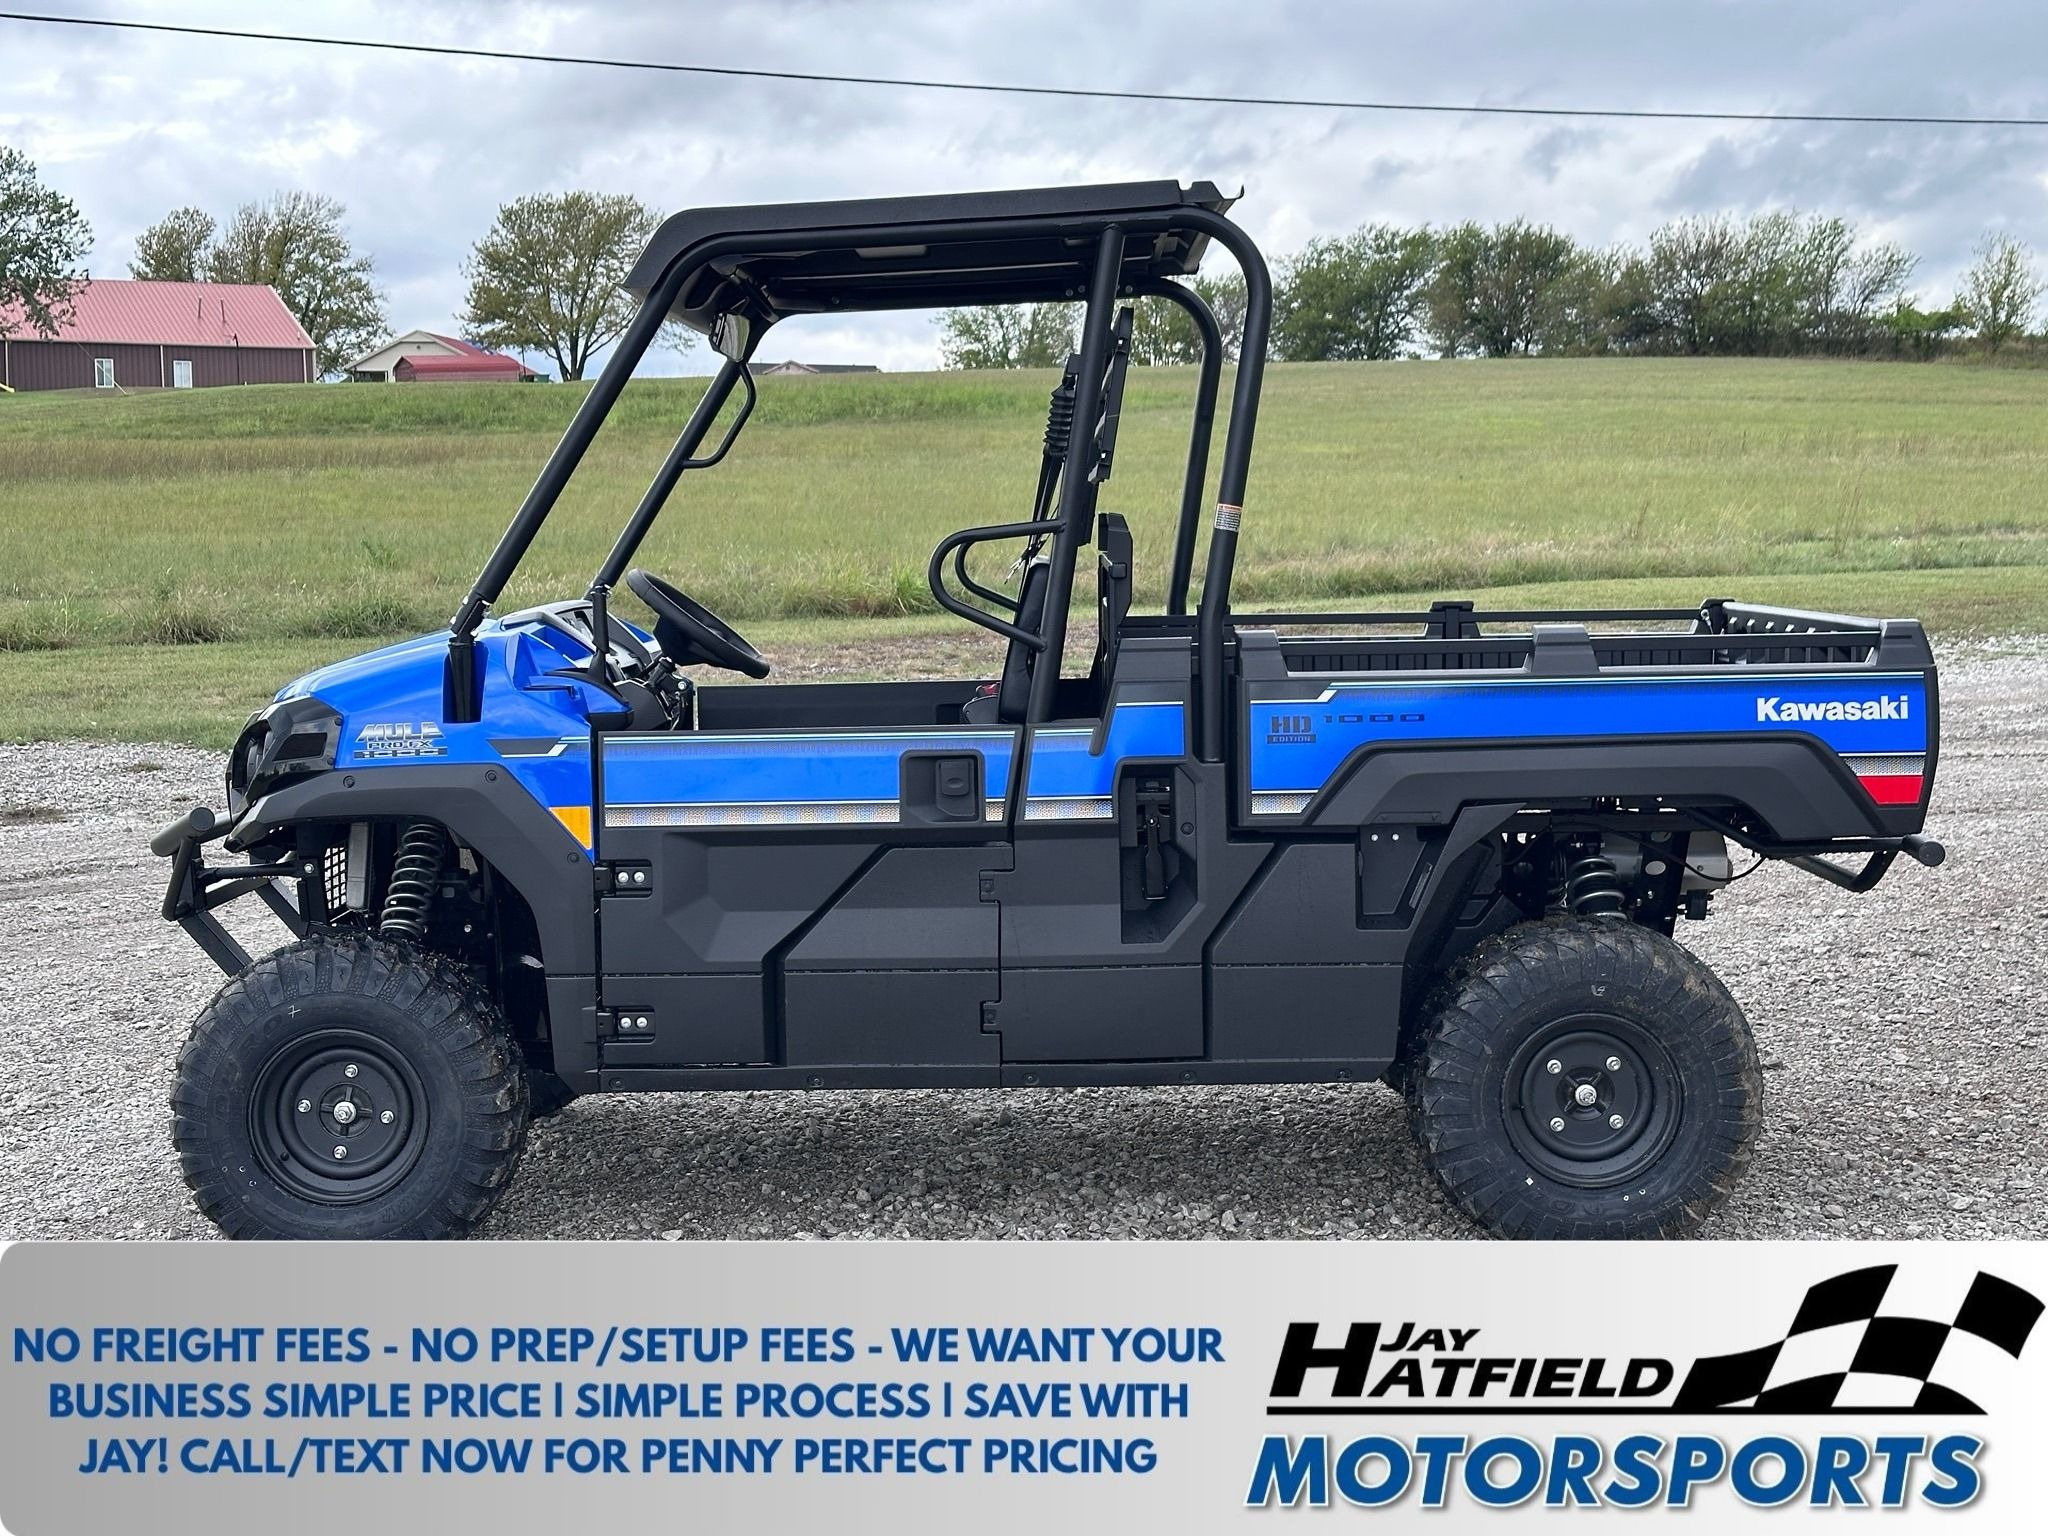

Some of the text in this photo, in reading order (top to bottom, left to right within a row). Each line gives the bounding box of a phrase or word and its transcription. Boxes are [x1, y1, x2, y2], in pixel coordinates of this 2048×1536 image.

[1323, 713, 1426, 723] 1000
[1756, 695, 1908, 722] Kawasaki
[355, 722, 446, 742] MULE
[1271, 715, 1312, 734] HD
[1272, 735, 1312, 743] EDITION
